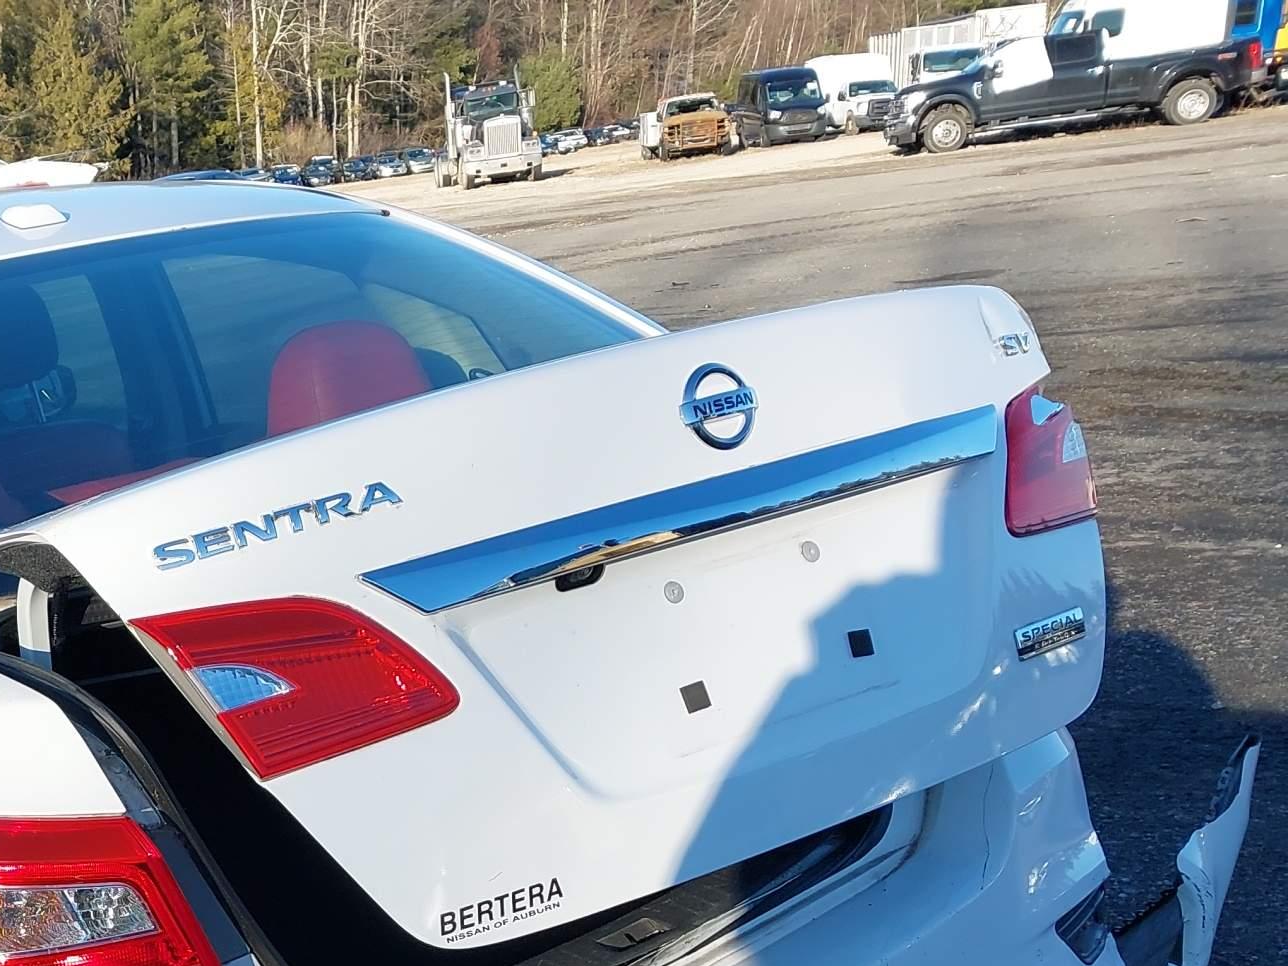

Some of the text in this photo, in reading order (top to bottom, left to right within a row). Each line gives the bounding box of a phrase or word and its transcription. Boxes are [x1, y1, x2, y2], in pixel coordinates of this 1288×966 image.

[692, 391, 754, 418] NISSAN
[152, 481, 405, 571] SENTRA
[1021, 612, 1082, 642] SPECIAL
[440, 877, 563, 936] BERTERA
[446, 901, 561, 944] NISSAN OF AUBURN
